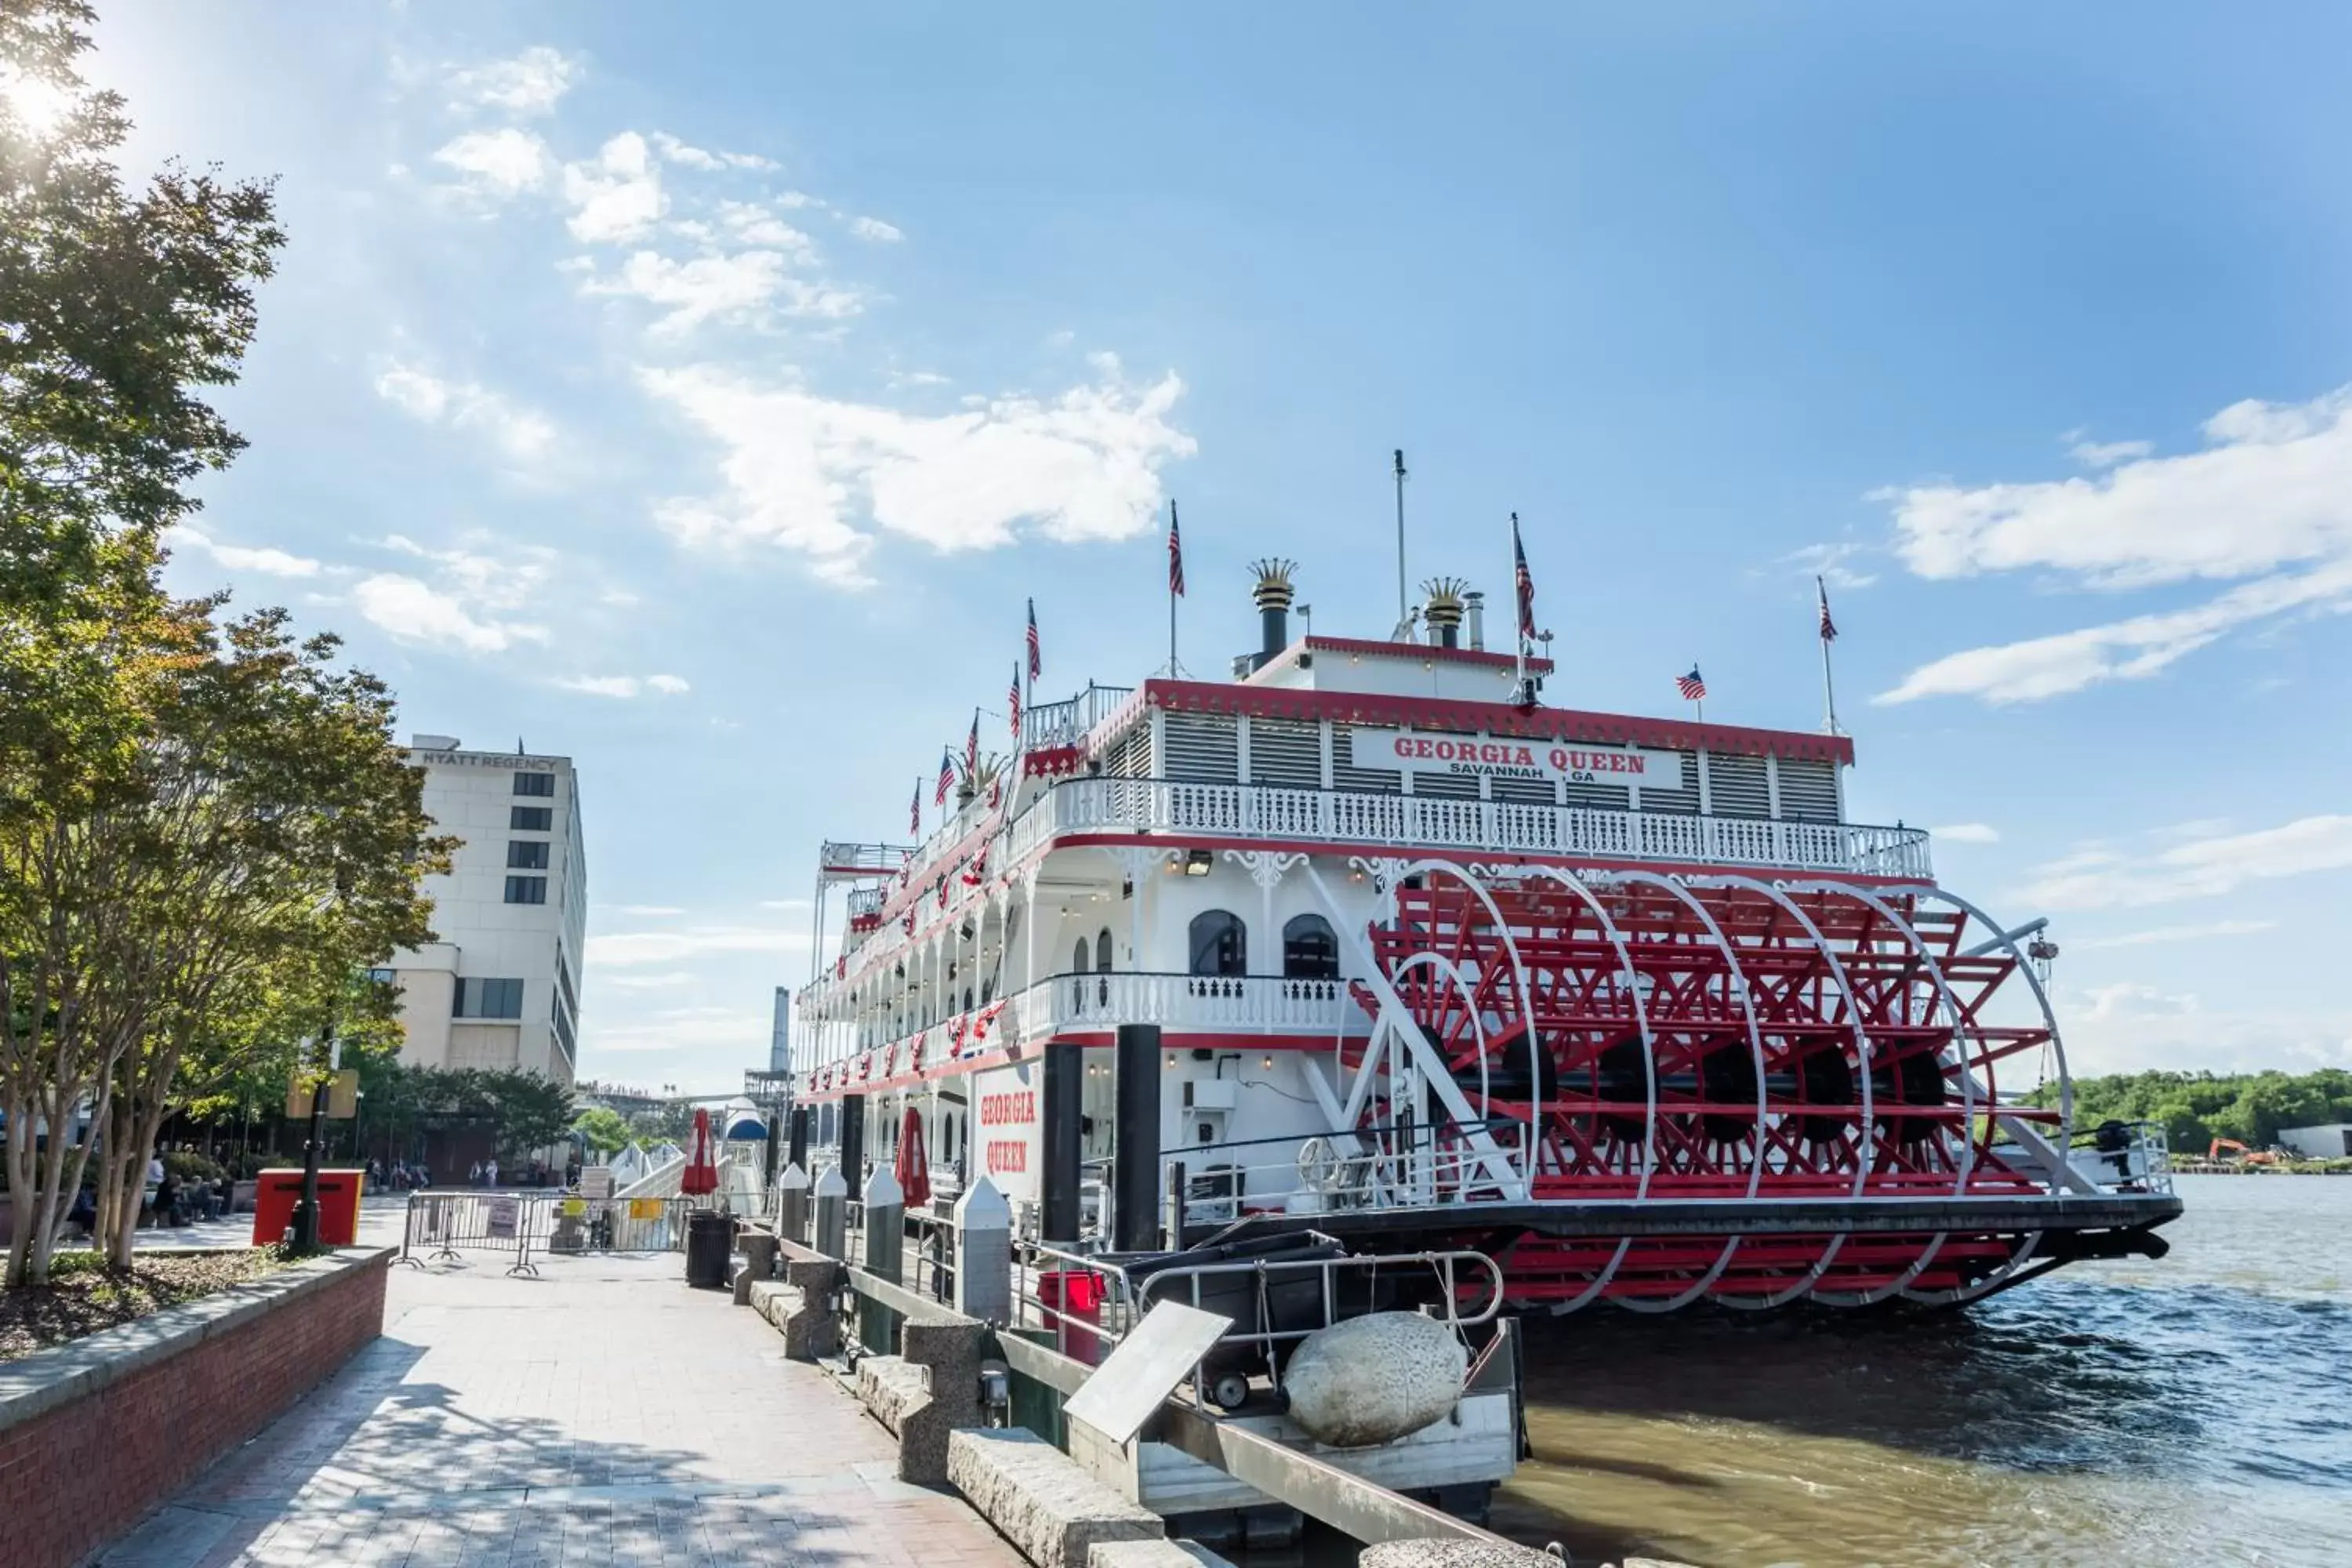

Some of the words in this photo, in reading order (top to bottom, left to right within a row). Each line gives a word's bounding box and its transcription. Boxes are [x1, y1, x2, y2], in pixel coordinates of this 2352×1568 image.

[423, 752, 477, 766] HYATT
[481, 757, 557, 771] REGENCY
[1394, 738, 1536, 766] GEORGIA
[1549, 749, 1646, 774] QUEEN
[1450, 762, 1544, 779] SAVANNAH
[981, 1091, 1036, 1126] GEORGIA
[987, 1141, 1028, 1175] QUEEN
